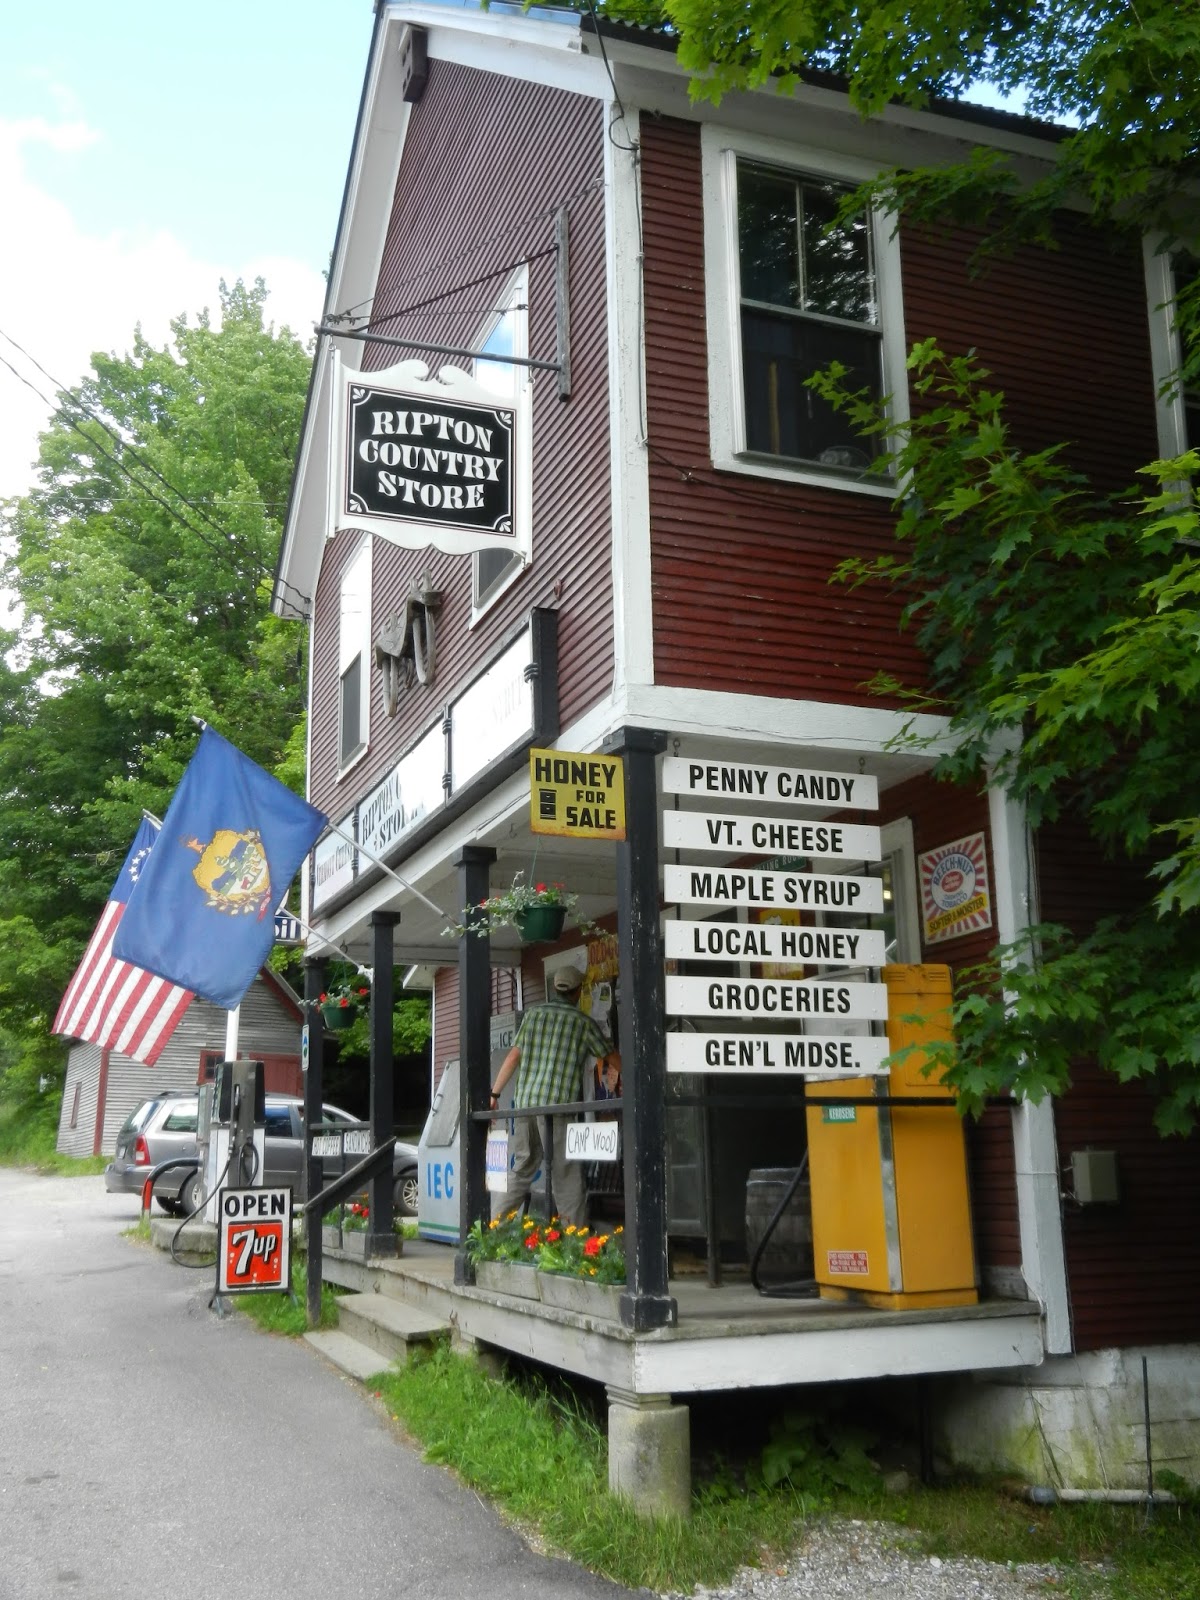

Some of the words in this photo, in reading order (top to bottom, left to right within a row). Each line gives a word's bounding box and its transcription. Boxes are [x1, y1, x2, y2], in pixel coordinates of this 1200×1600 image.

[371, 411, 493, 453] RIPTON
[359, 439, 504, 482] COUNTRY
[377, 470, 485, 510] STORE
[535, 757, 617, 788] HONEY
[689, 764, 769, 795] PENNY
[777, 772, 855, 802] CANDY
[576, 789, 606, 804] FOR
[566, 805, 617, 830] SALE
[706, 819, 742, 846] VT.
[751, 822, 844, 853] CHEESE
[932, 856, 974, 886] BEECH-NUT
[690, 872, 775, 902] MAPLE
[784, 877, 861, 906] SYRUP
[929, 913, 952, 931] SOFTER
[956, 897, 985, 917] MOISTER
[693, 927, 773, 956] LOCAL
[781, 931, 860, 960] HONEY
[708, 983, 851, 1014] GROCERIES
[499, 1030, 514, 1048] ICE
[704, 1039, 776, 1067] GEN'L
[784, 1041, 861, 1068] MDSE.
[567, 1126, 590, 1154] CAMP
[592, 1128, 617, 1154] WOOD
[224, 1193, 286, 1218] OPEN
